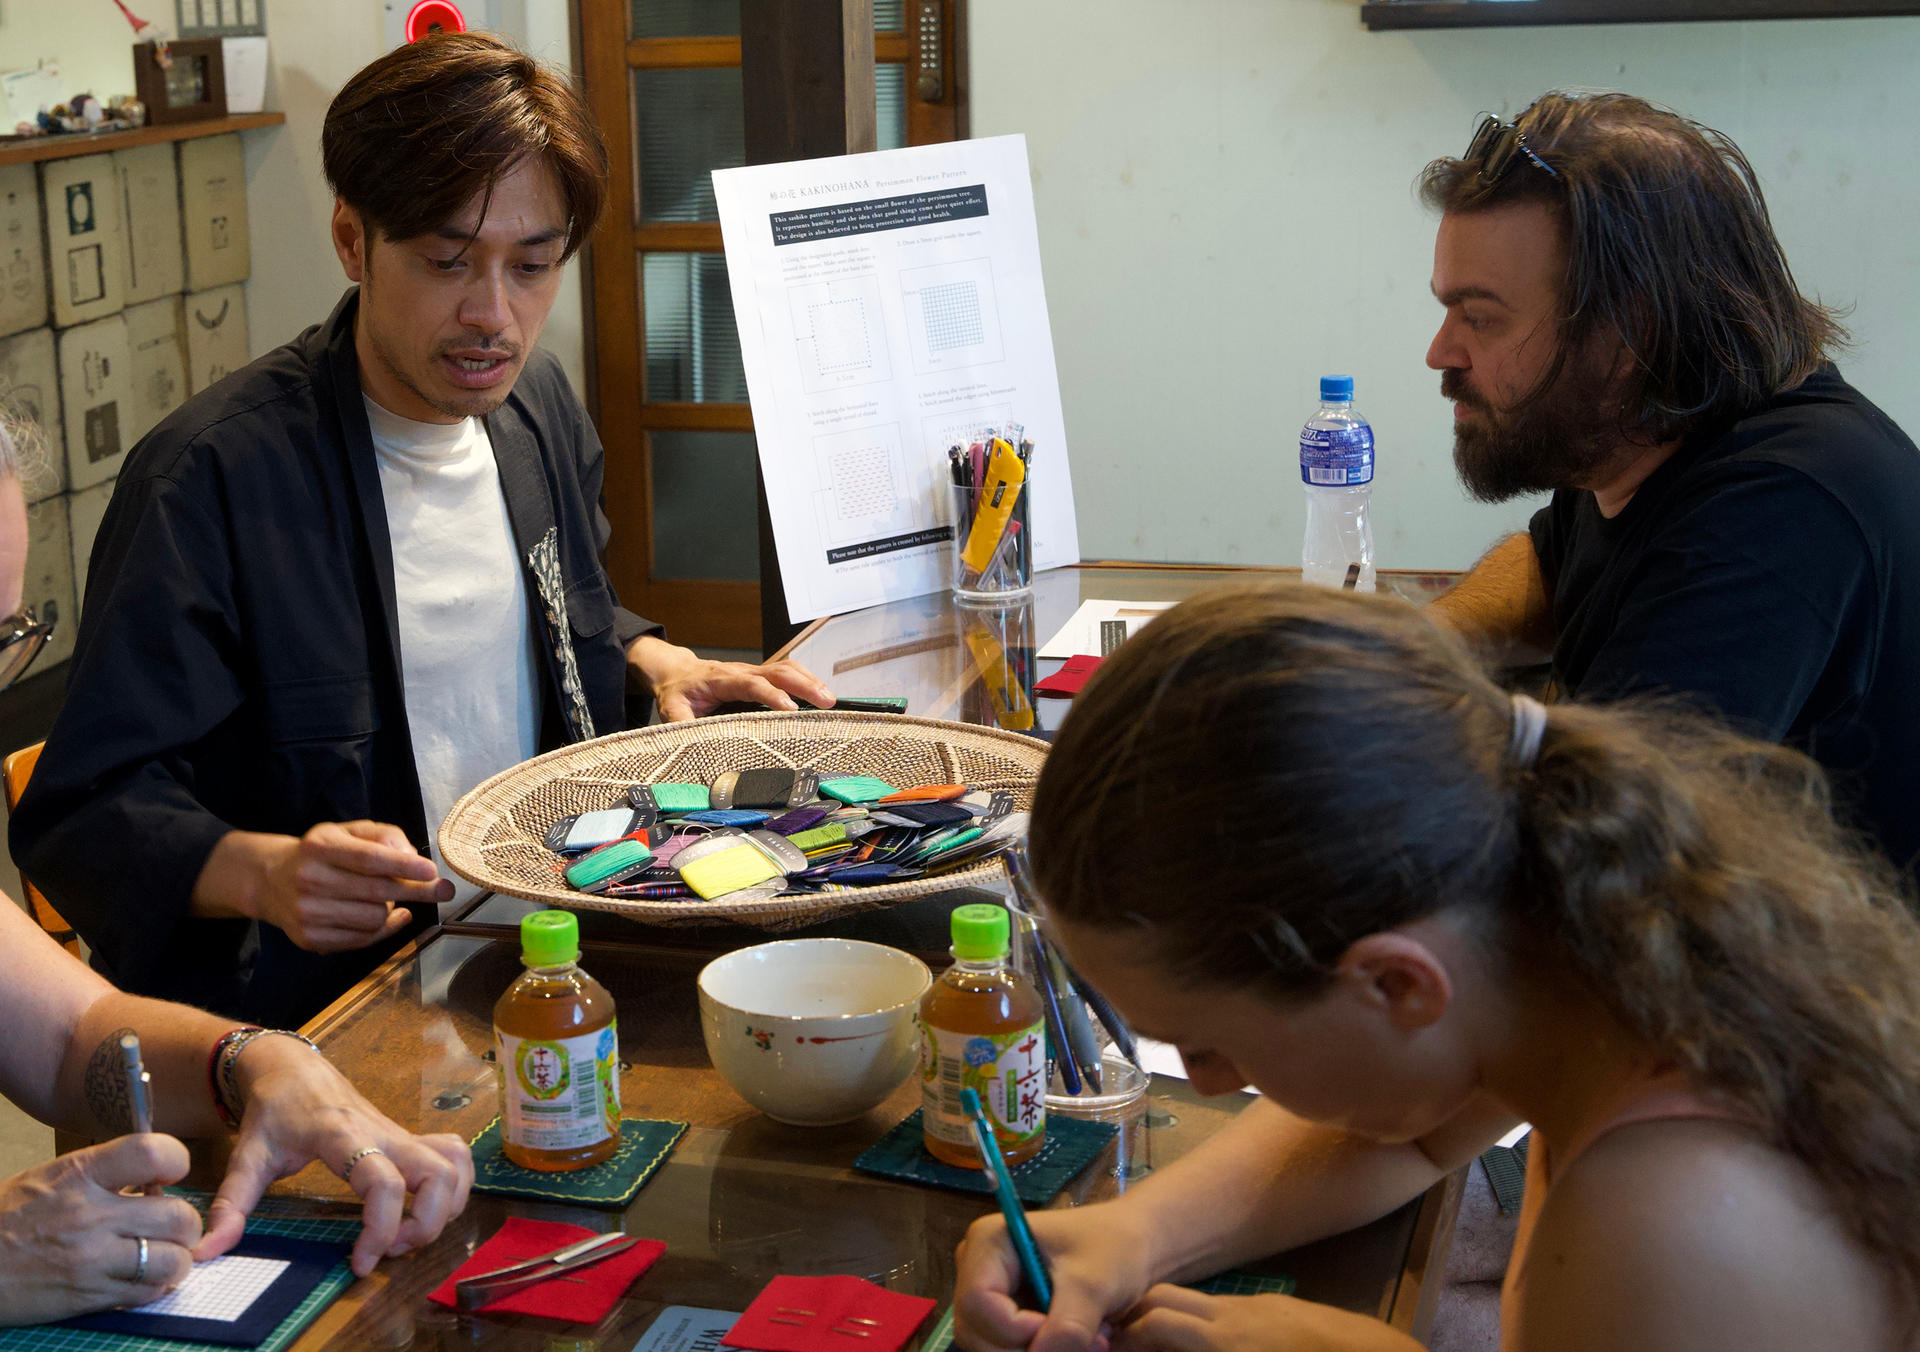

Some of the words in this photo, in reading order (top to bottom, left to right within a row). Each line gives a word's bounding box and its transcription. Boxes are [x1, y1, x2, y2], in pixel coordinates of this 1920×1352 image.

[799, 180, 869, 196] KAKINOHANA
[875, 177, 913, 186] Persimmon
[915, 173, 940, 181] Flower
[941, 170, 968, 178] Pattern
[782, 222, 810, 232] represents
[811, 219, 834, 228] humility
[884, 209, 898, 217] good
[899, 207, 918, 215] things
[949, 200, 964, 208] quiet
[788, 213, 807, 221] sashiko
[809, 210, 829, 219] pattern
[927, 192, 958, 202] persimmon
[789, 231, 807, 240] design
[827, 225, 851, 233] believed
[859, 222, 874, 230] bring
[875, 217, 904, 228] protection
[917, 213, 932, 222] good
[831, 550, 847, 559] Please
[846, 548, 856, 556] note
[875, 541, 892, 551] pattern
[897, 536, 914, 545] created
[766, 836, 796, 860] SASHIKO
[533, 1047, 553, 1091] 十六茶
[1017, 1034, 1042, 1131] 十六茶
